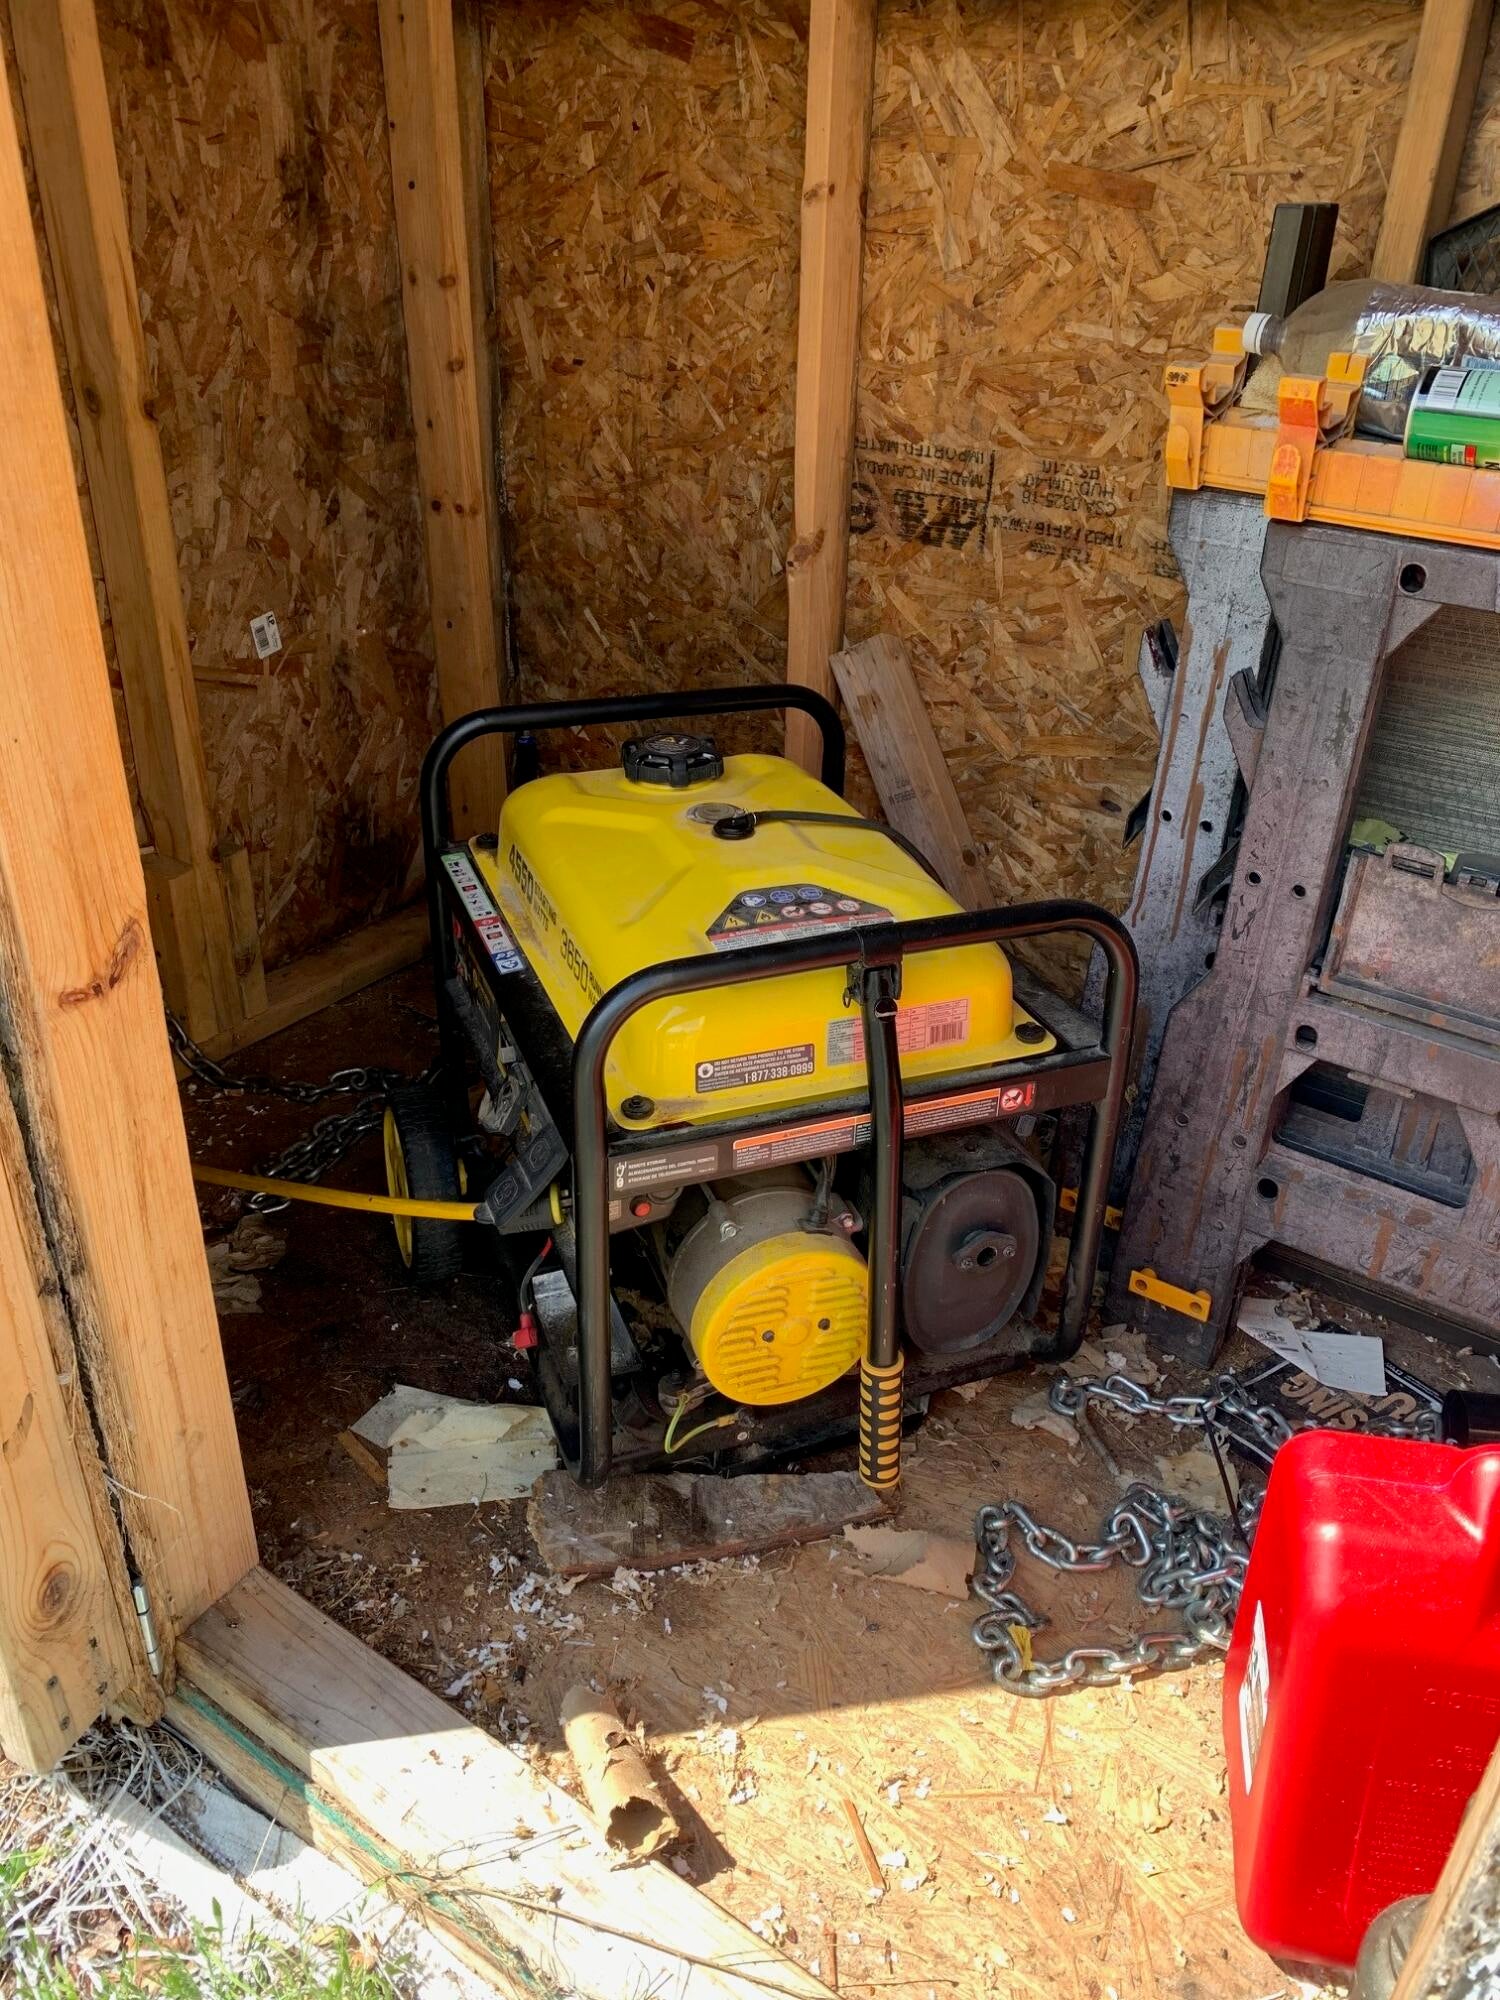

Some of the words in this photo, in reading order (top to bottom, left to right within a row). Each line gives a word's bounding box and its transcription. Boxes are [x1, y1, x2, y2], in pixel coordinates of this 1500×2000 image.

[904, 443, 984, 464] IMPORTED
[920, 467, 936, 484] IN
[935, 470, 984, 490] MADE
[508, 844, 535, 904] 4550
[560, 928, 588, 992] 3650
